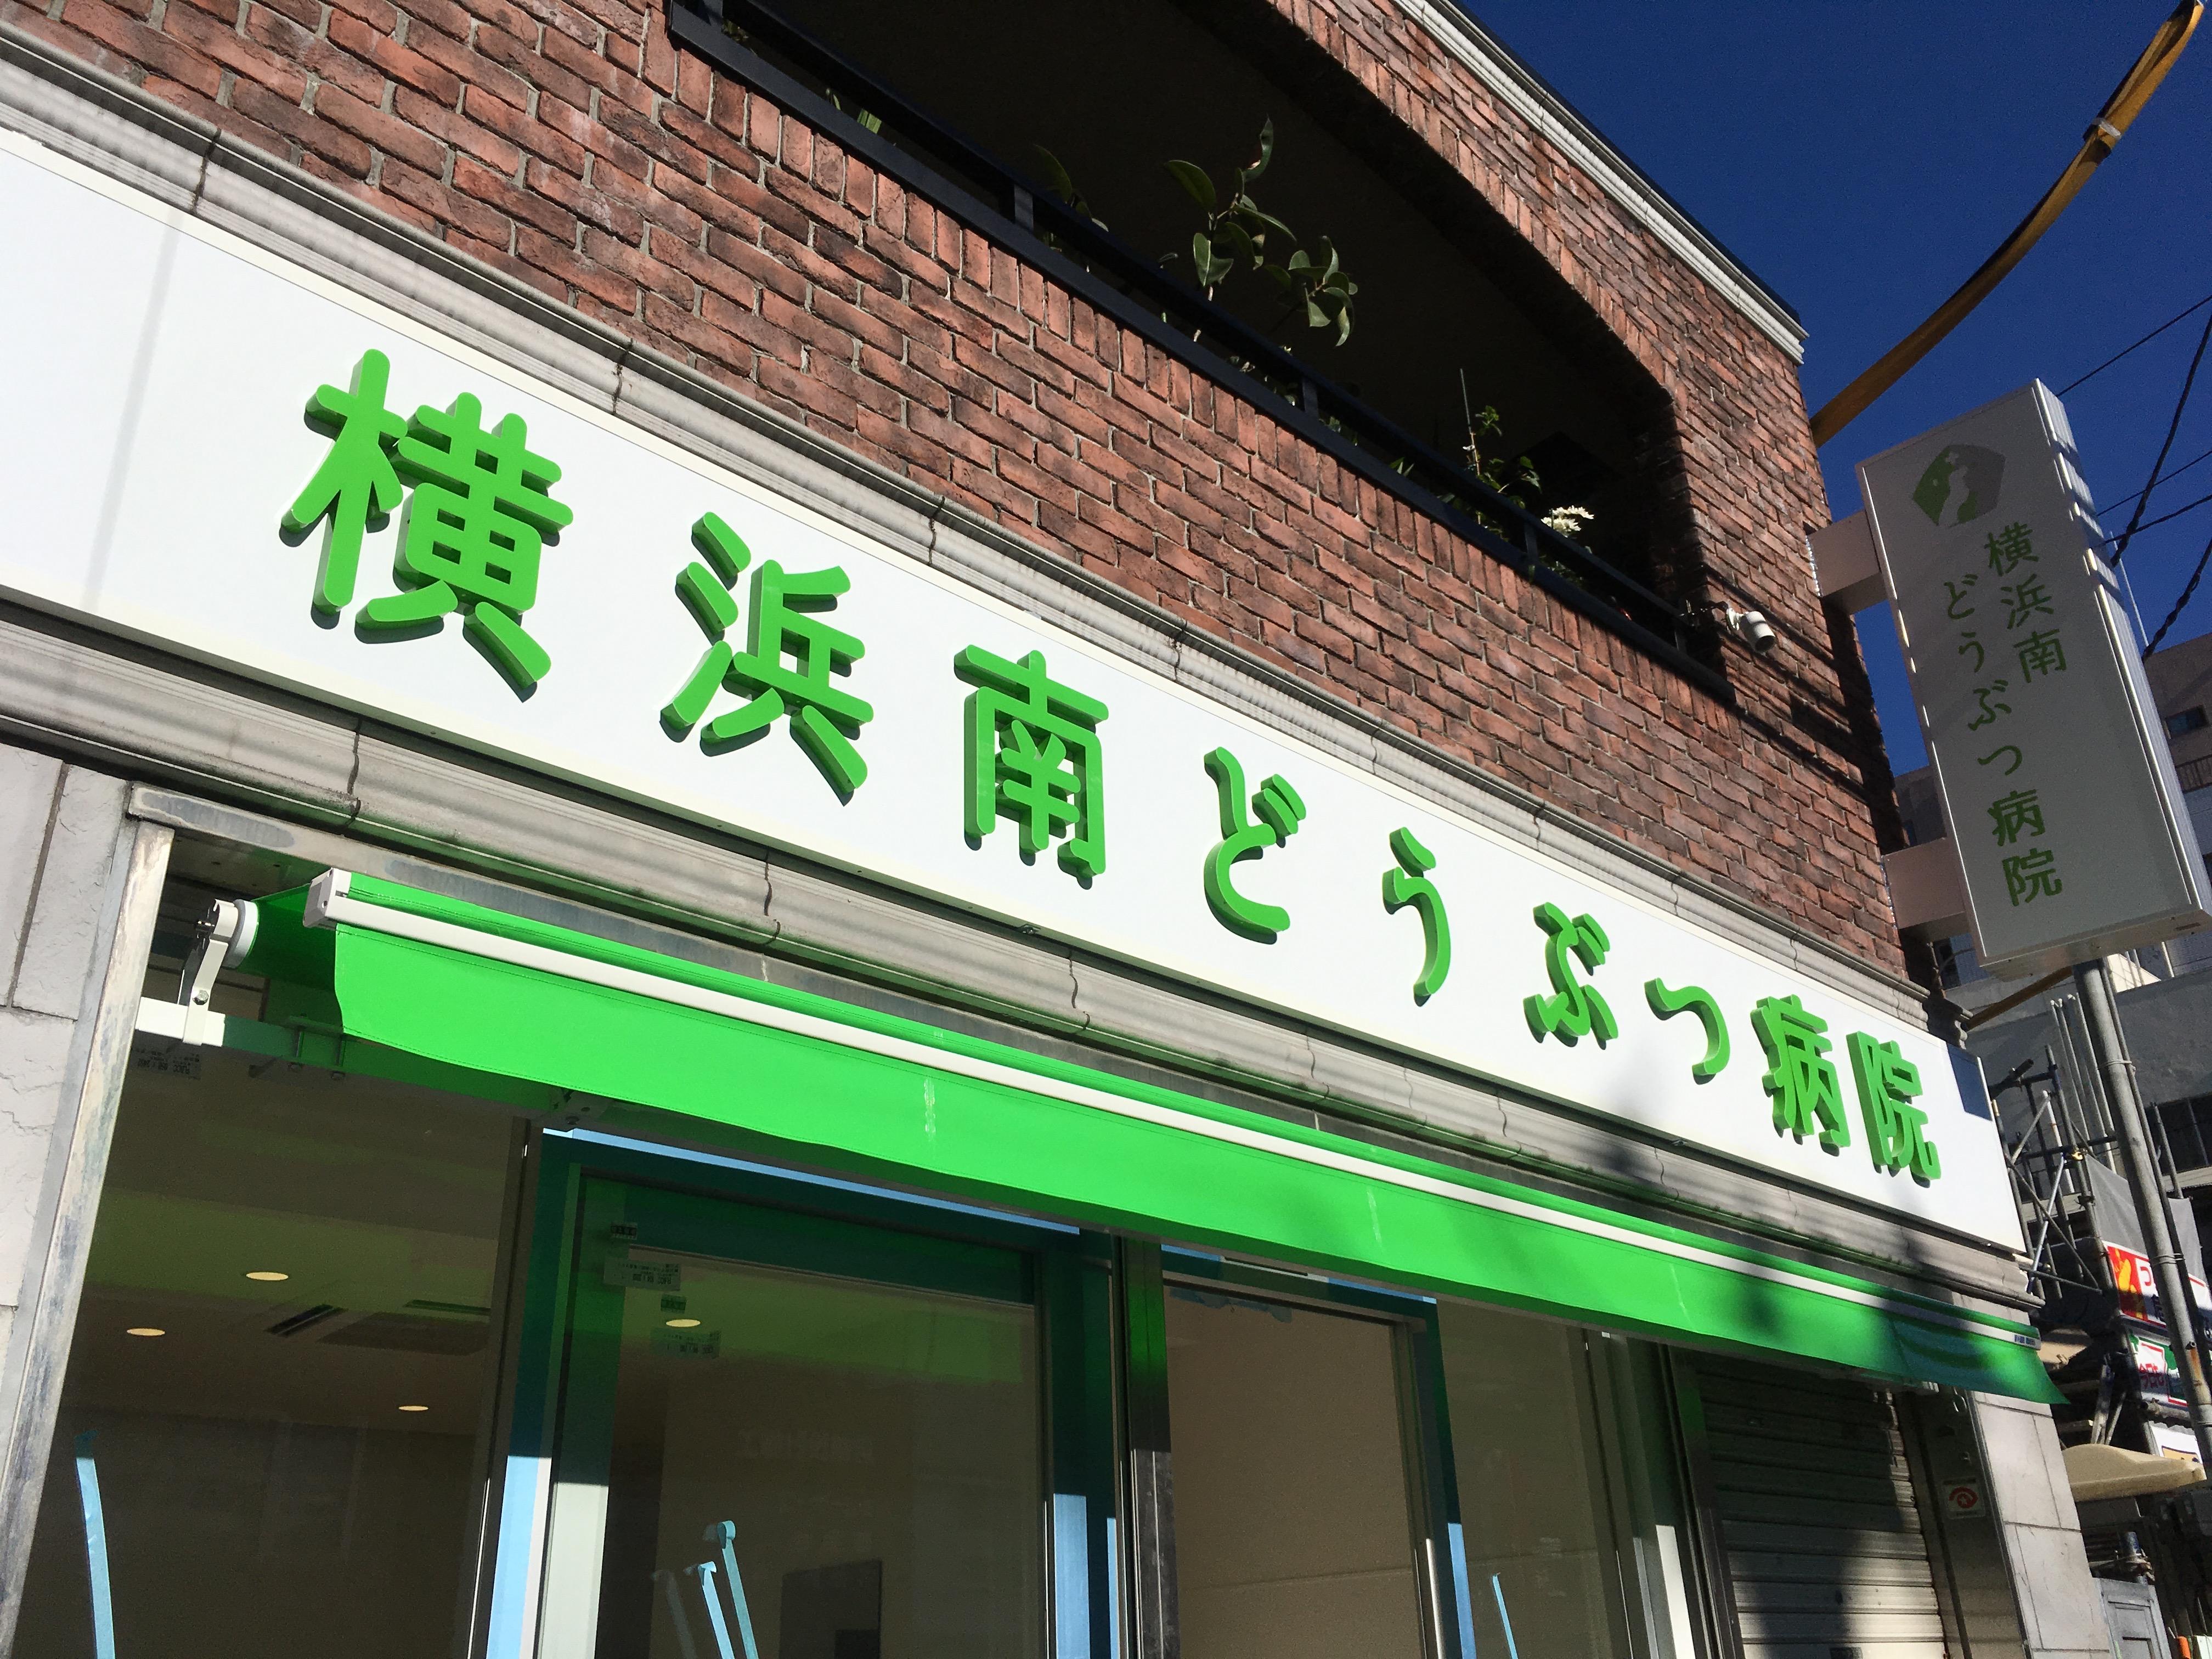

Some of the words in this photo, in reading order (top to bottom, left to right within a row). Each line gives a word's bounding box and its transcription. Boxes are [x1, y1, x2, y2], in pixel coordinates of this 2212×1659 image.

[280, 348, 1942, 1181] 横浜南どうぶつ病院
[1943, 572, 2063, 907] どうぶつ病院
[1983, 521, 2068, 684] 横浜南
